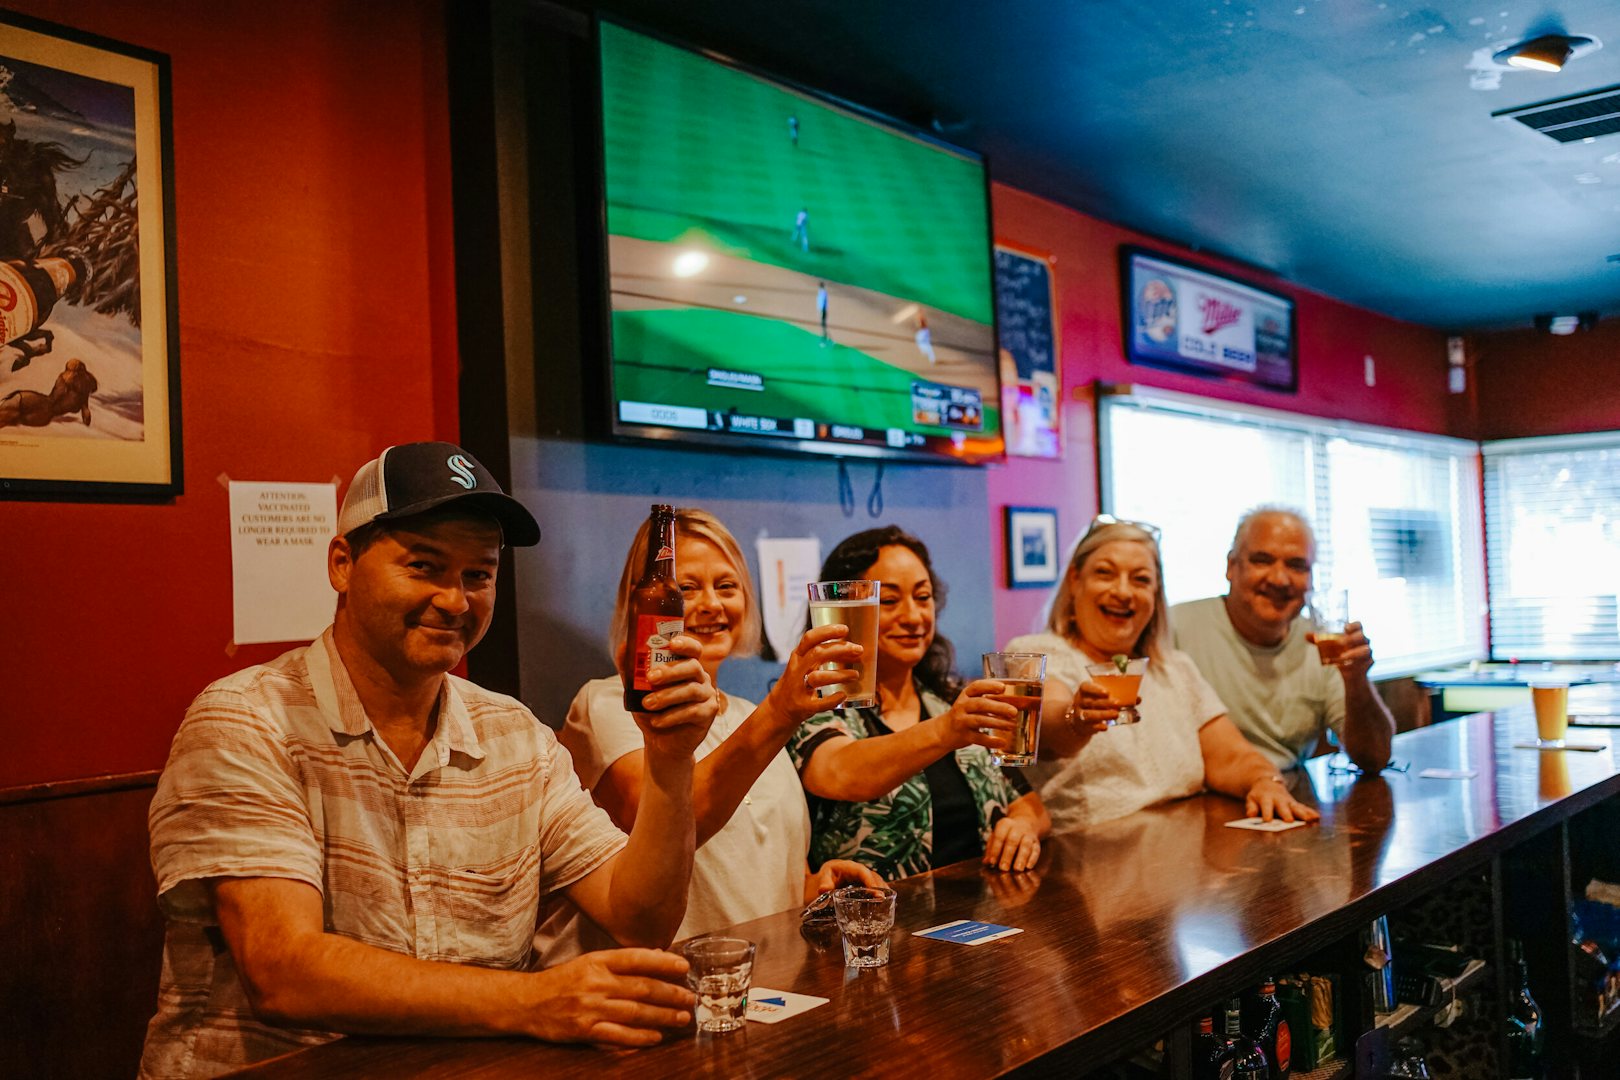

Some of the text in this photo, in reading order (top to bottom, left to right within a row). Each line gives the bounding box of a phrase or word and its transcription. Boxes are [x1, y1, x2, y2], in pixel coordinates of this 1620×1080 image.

[258, 503, 311, 512] VACCINATED
[242, 514, 293, 523] CUSTOMERS
[238, 526, 273, 534] LONGER
[275, 526, 317, 535] REQUIRED
[256, 538, 280, 546] WEAR
